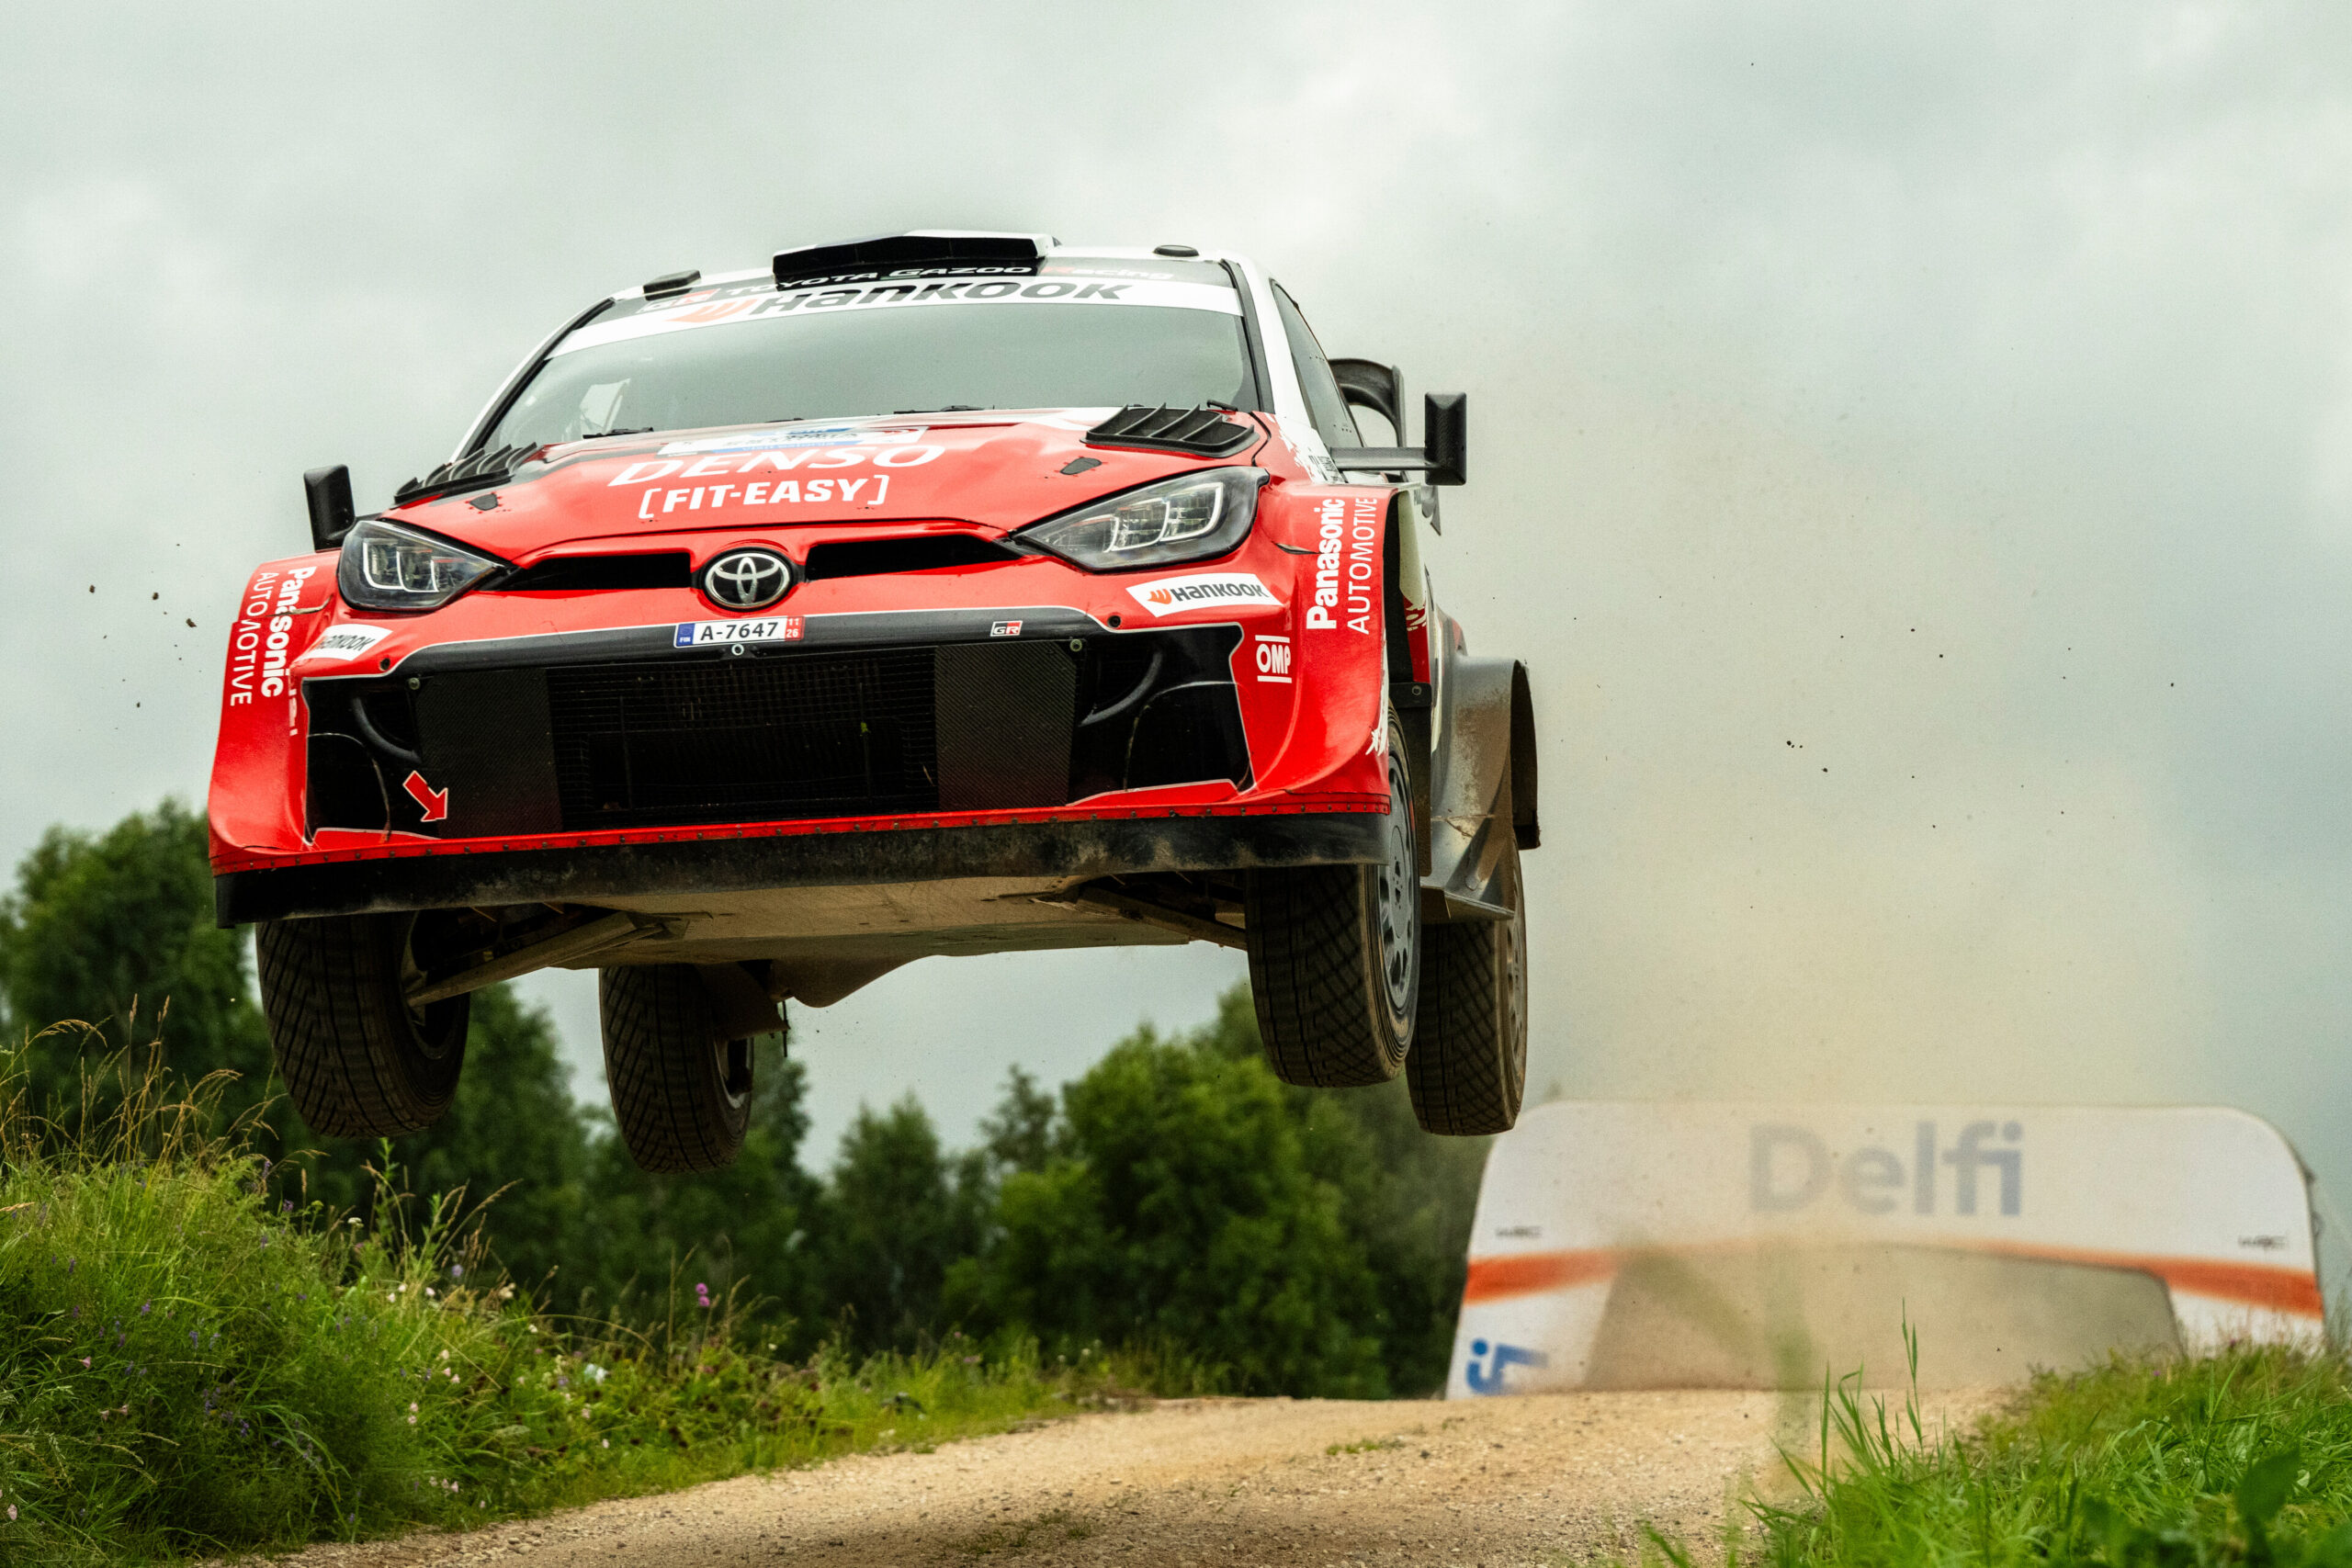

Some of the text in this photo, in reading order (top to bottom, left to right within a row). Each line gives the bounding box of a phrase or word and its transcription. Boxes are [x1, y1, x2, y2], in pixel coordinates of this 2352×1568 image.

[726, 272, 878, 296] TOYOTA
[888, 266, 1034, 277] GAZOO
[607, 445, 945, 486] DENSO
[639, 474, 890, 519] [FIT-EASY]
[1306, 499, 1345, 629] Panasonic
[1347, 498, 1377, 635] AUTOMOTIVE
[700, 622, 778, 641] A-7647
[786, 628, 798, 637] 26
[787, 618, 799, 626] 11
[993, 626, 1019, 635] GR
[1256, 643, 1291, 674] OMP
[1749, 1121, 2023, 1215] Delfi
